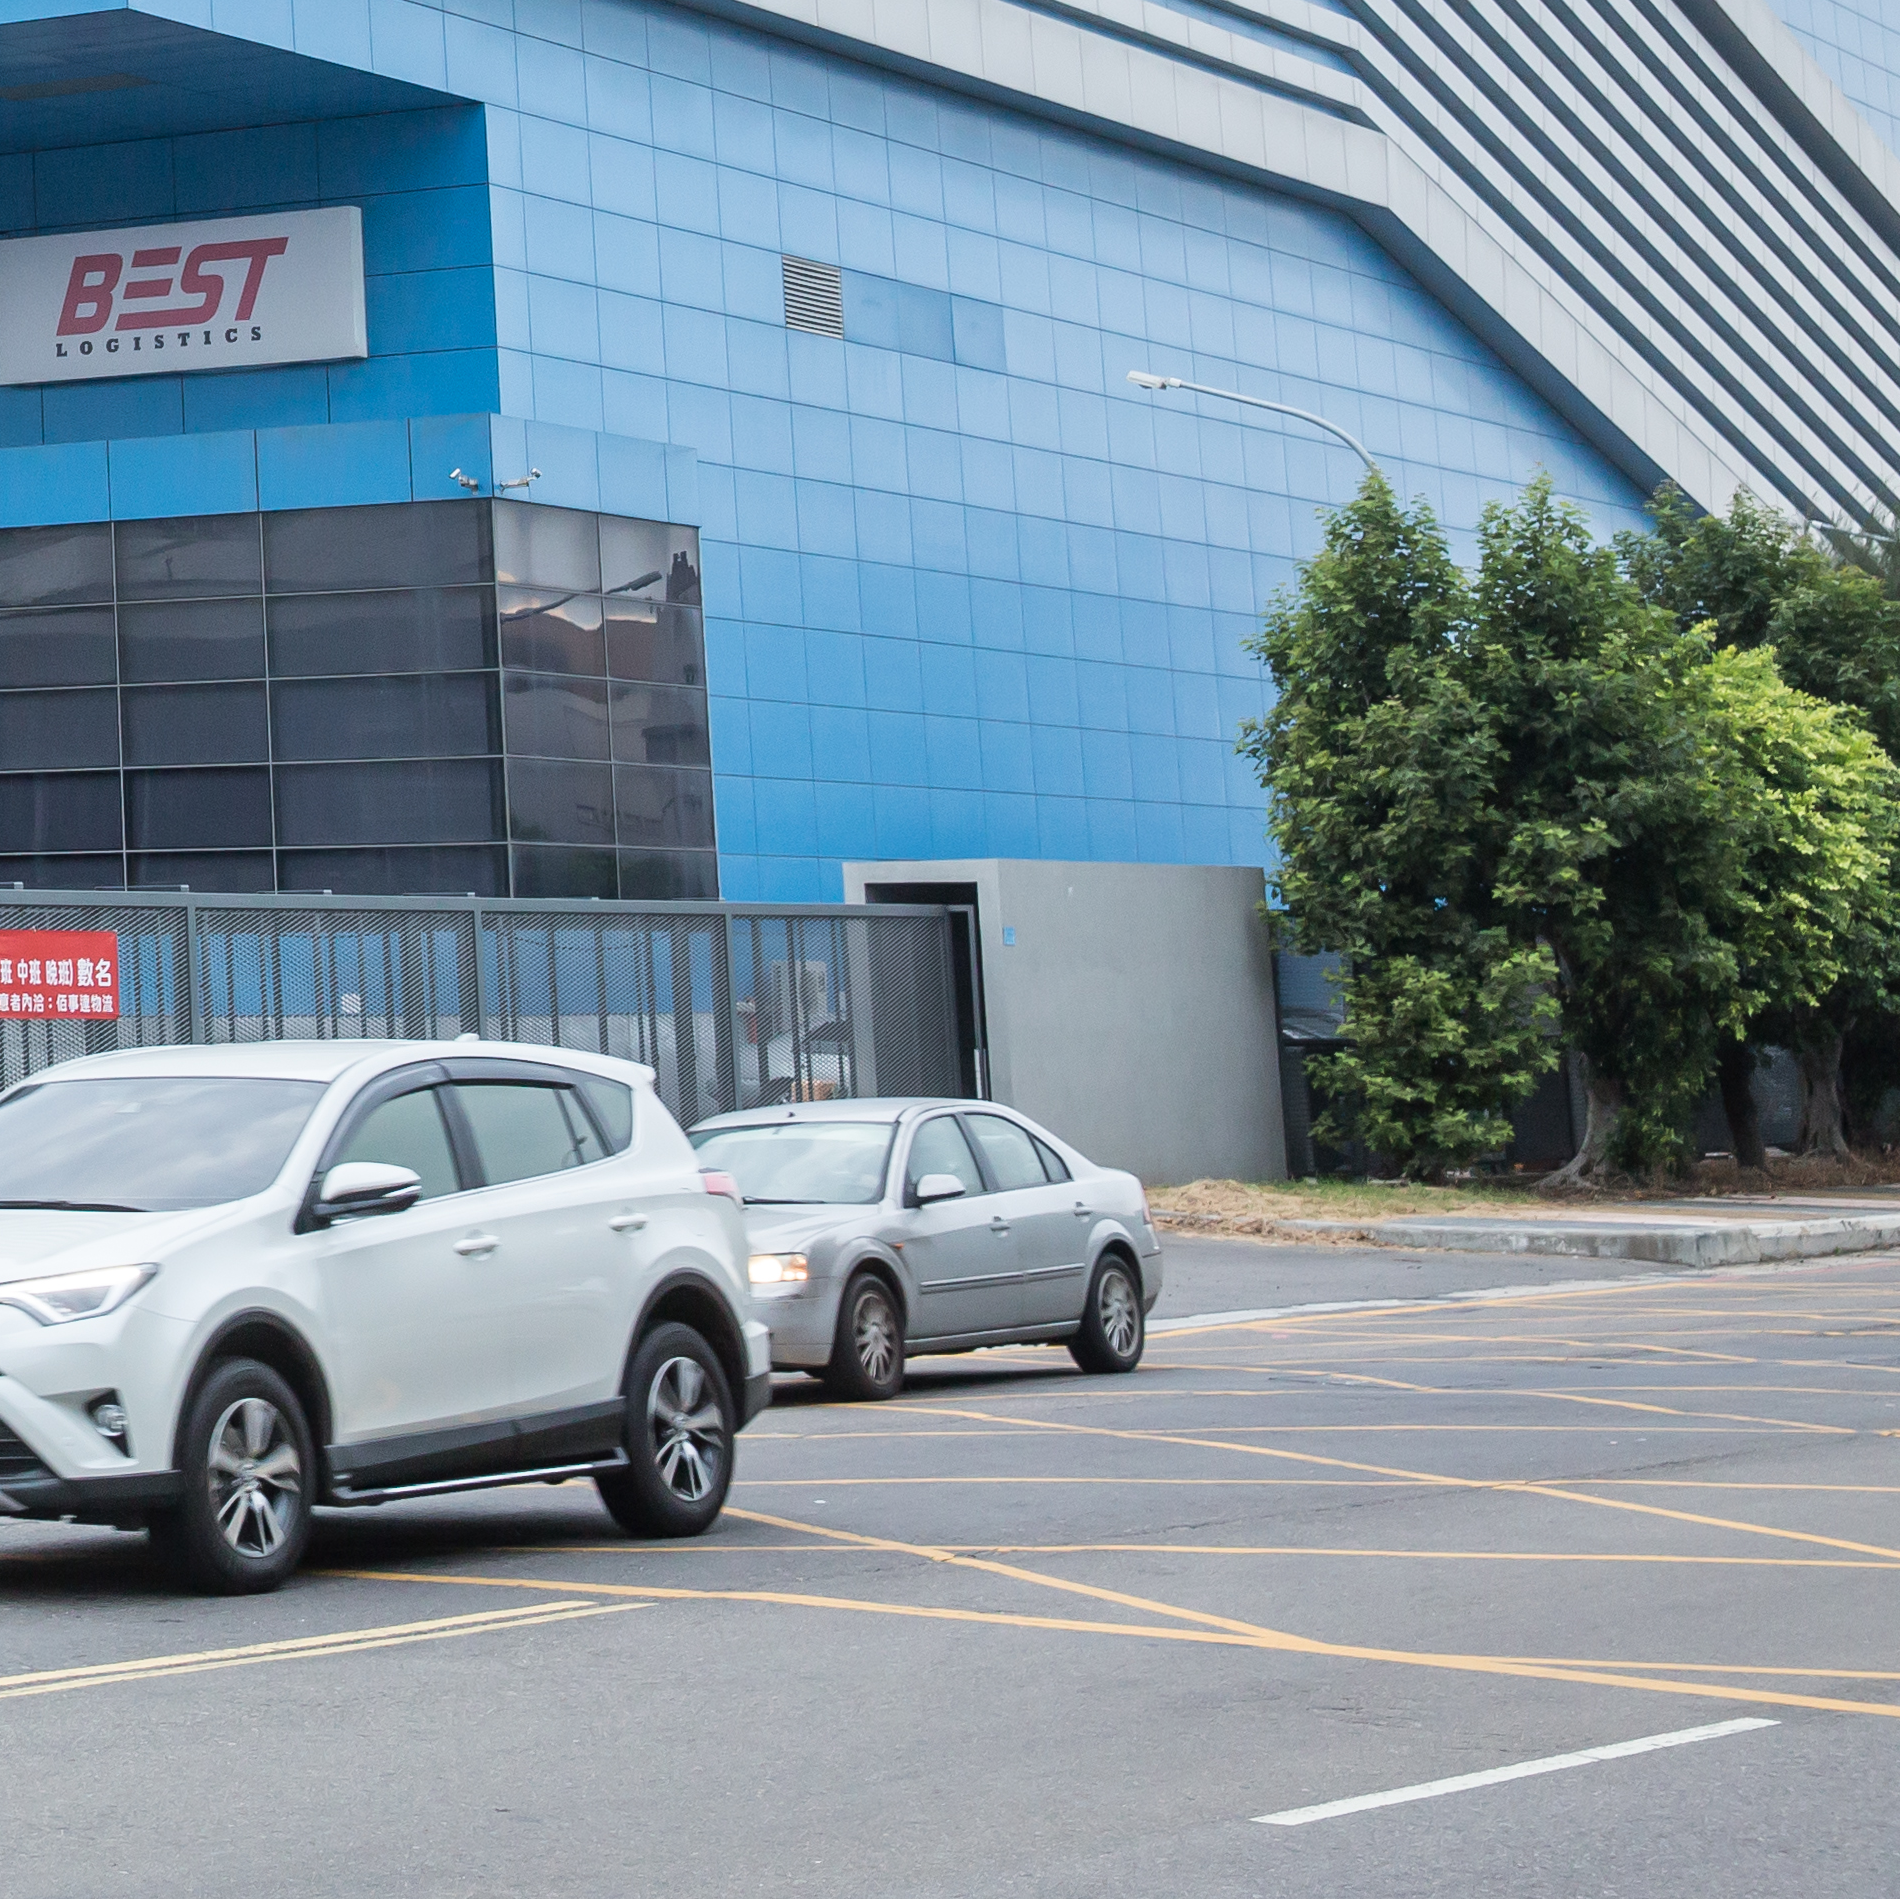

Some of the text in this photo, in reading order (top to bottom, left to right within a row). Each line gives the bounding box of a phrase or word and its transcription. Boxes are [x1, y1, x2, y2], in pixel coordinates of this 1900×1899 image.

[55, 236, 290, 337] BEST
[56, 326, 262, 358] LOGISTICS
[77, 957, 112, 987] 數名
